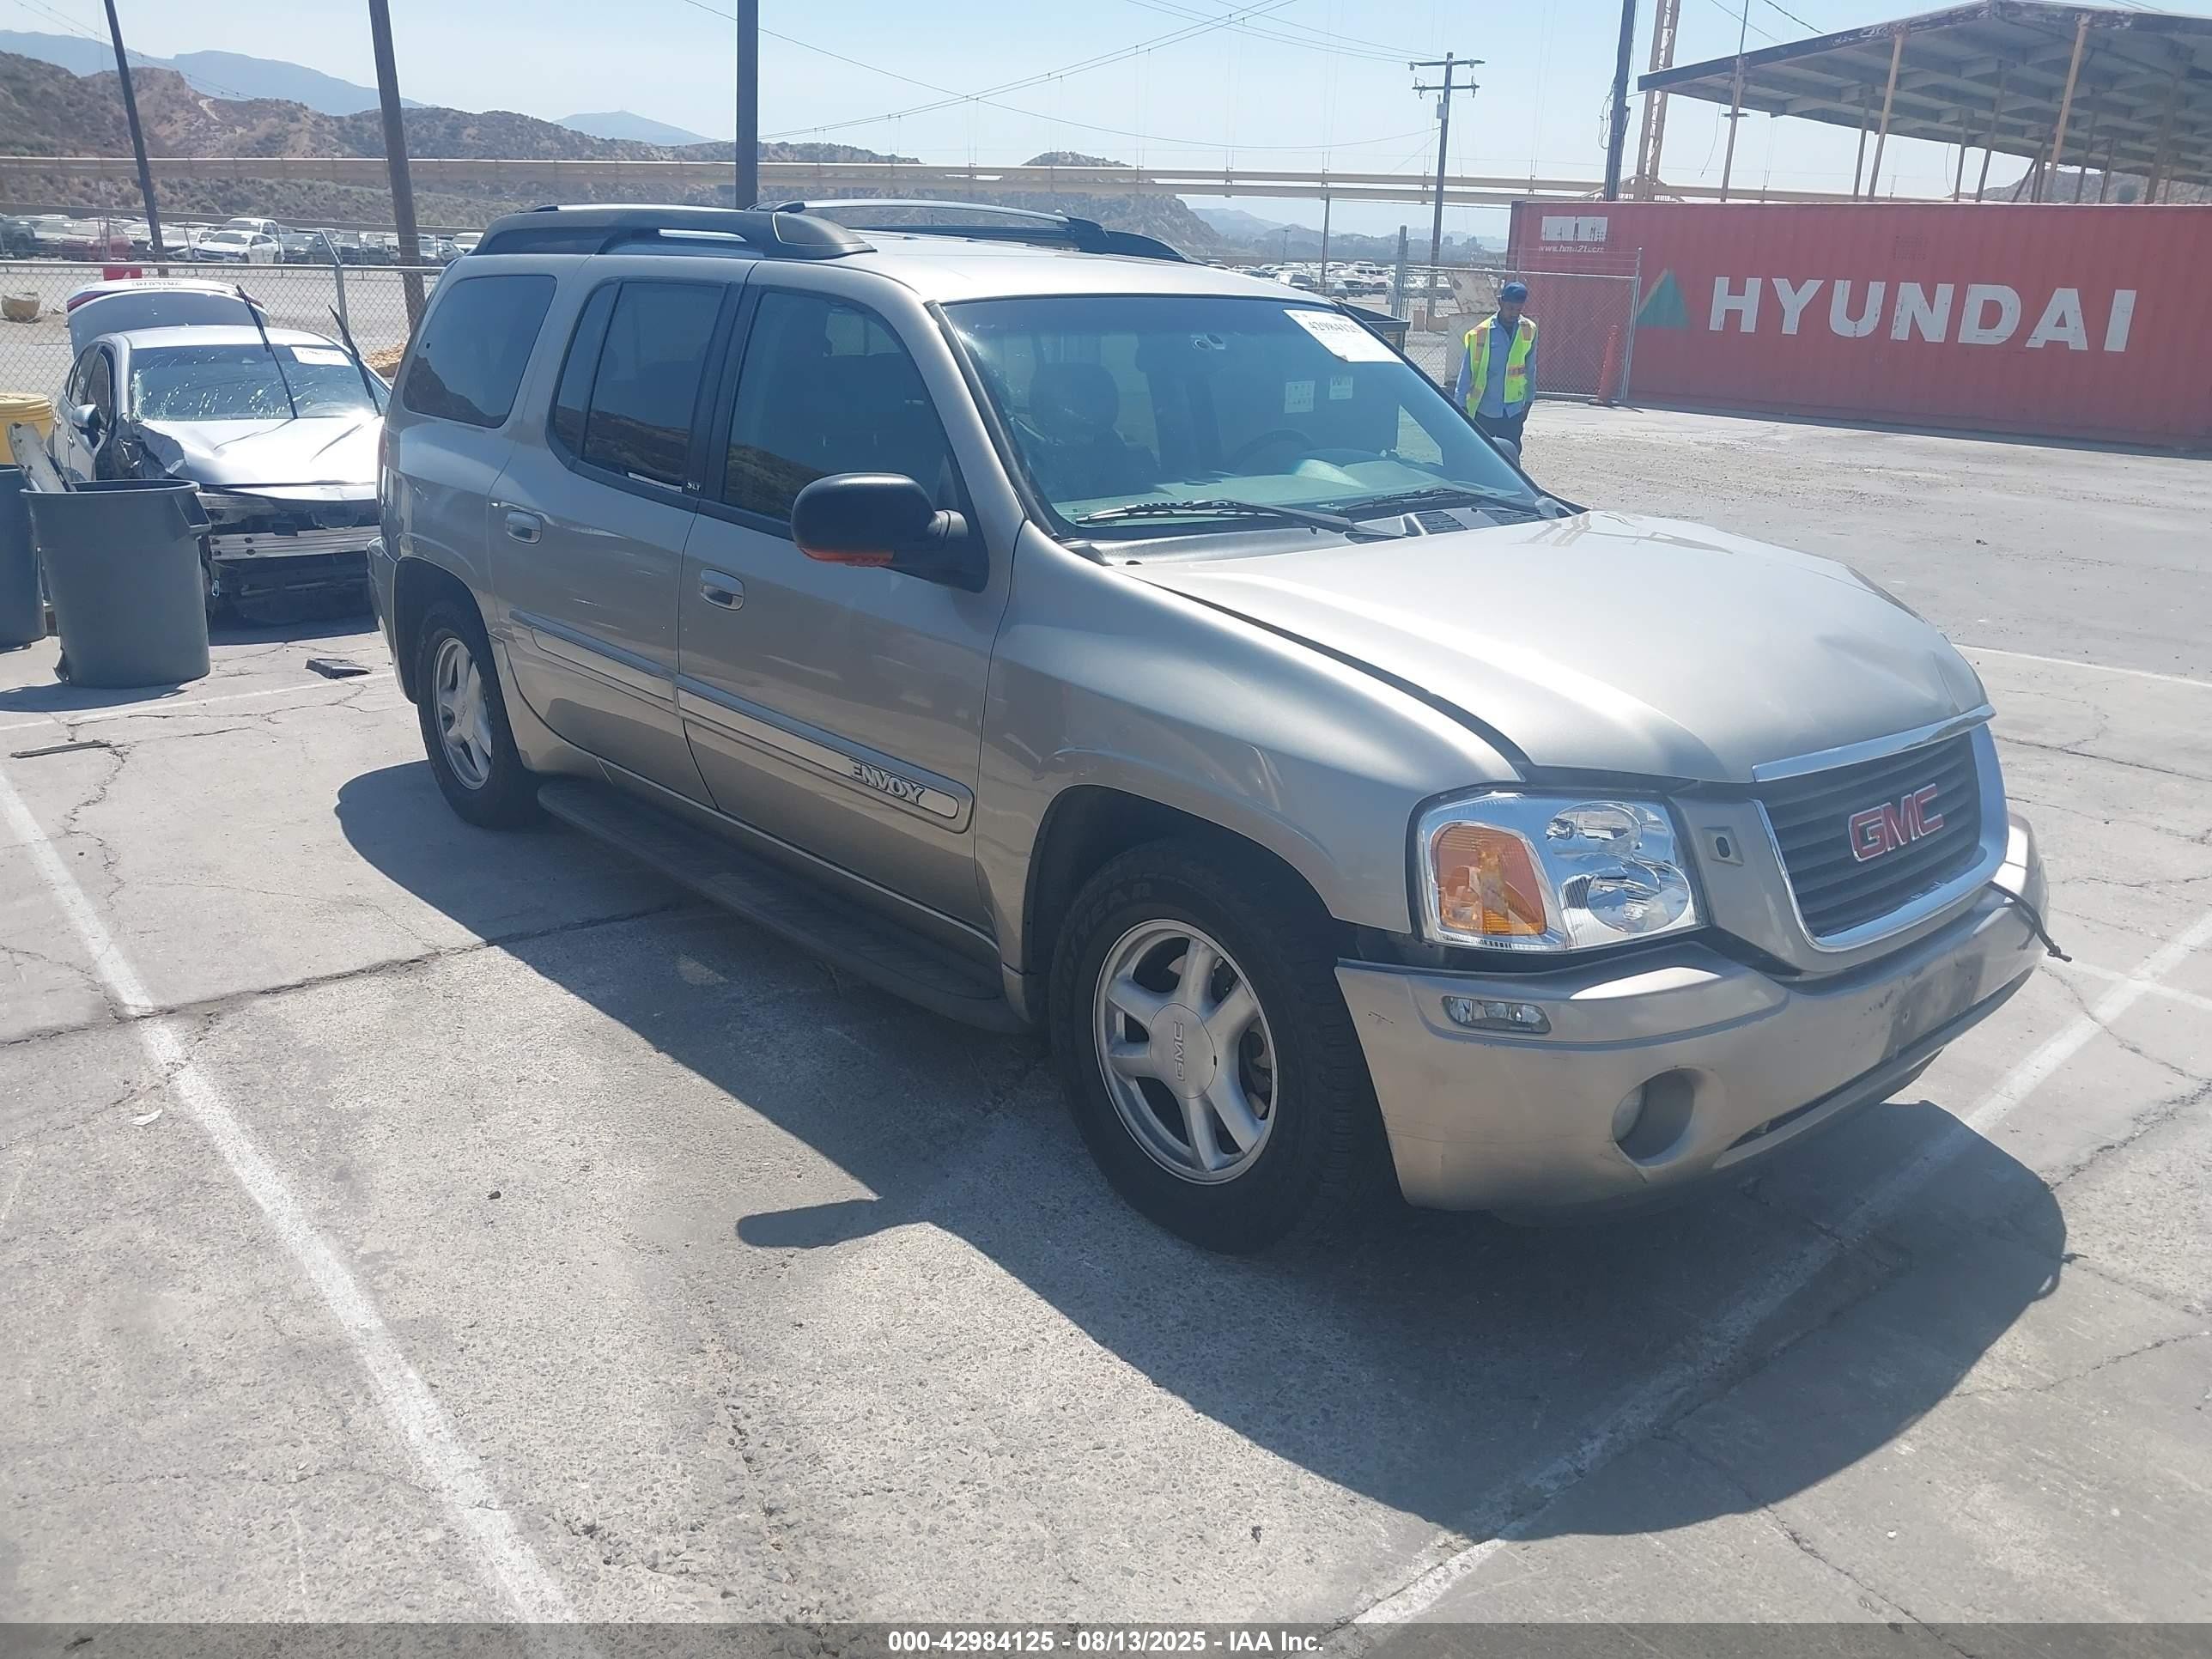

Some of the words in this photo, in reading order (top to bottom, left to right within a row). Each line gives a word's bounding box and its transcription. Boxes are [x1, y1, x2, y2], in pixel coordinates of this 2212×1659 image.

[1708, 276, 2137, 352] HYUNDAI
[849, 758, 926, 804] ENVOY
[1848, 782, 1944, 862] GMC
[1174, 1021, 1185, 1081] GMC
